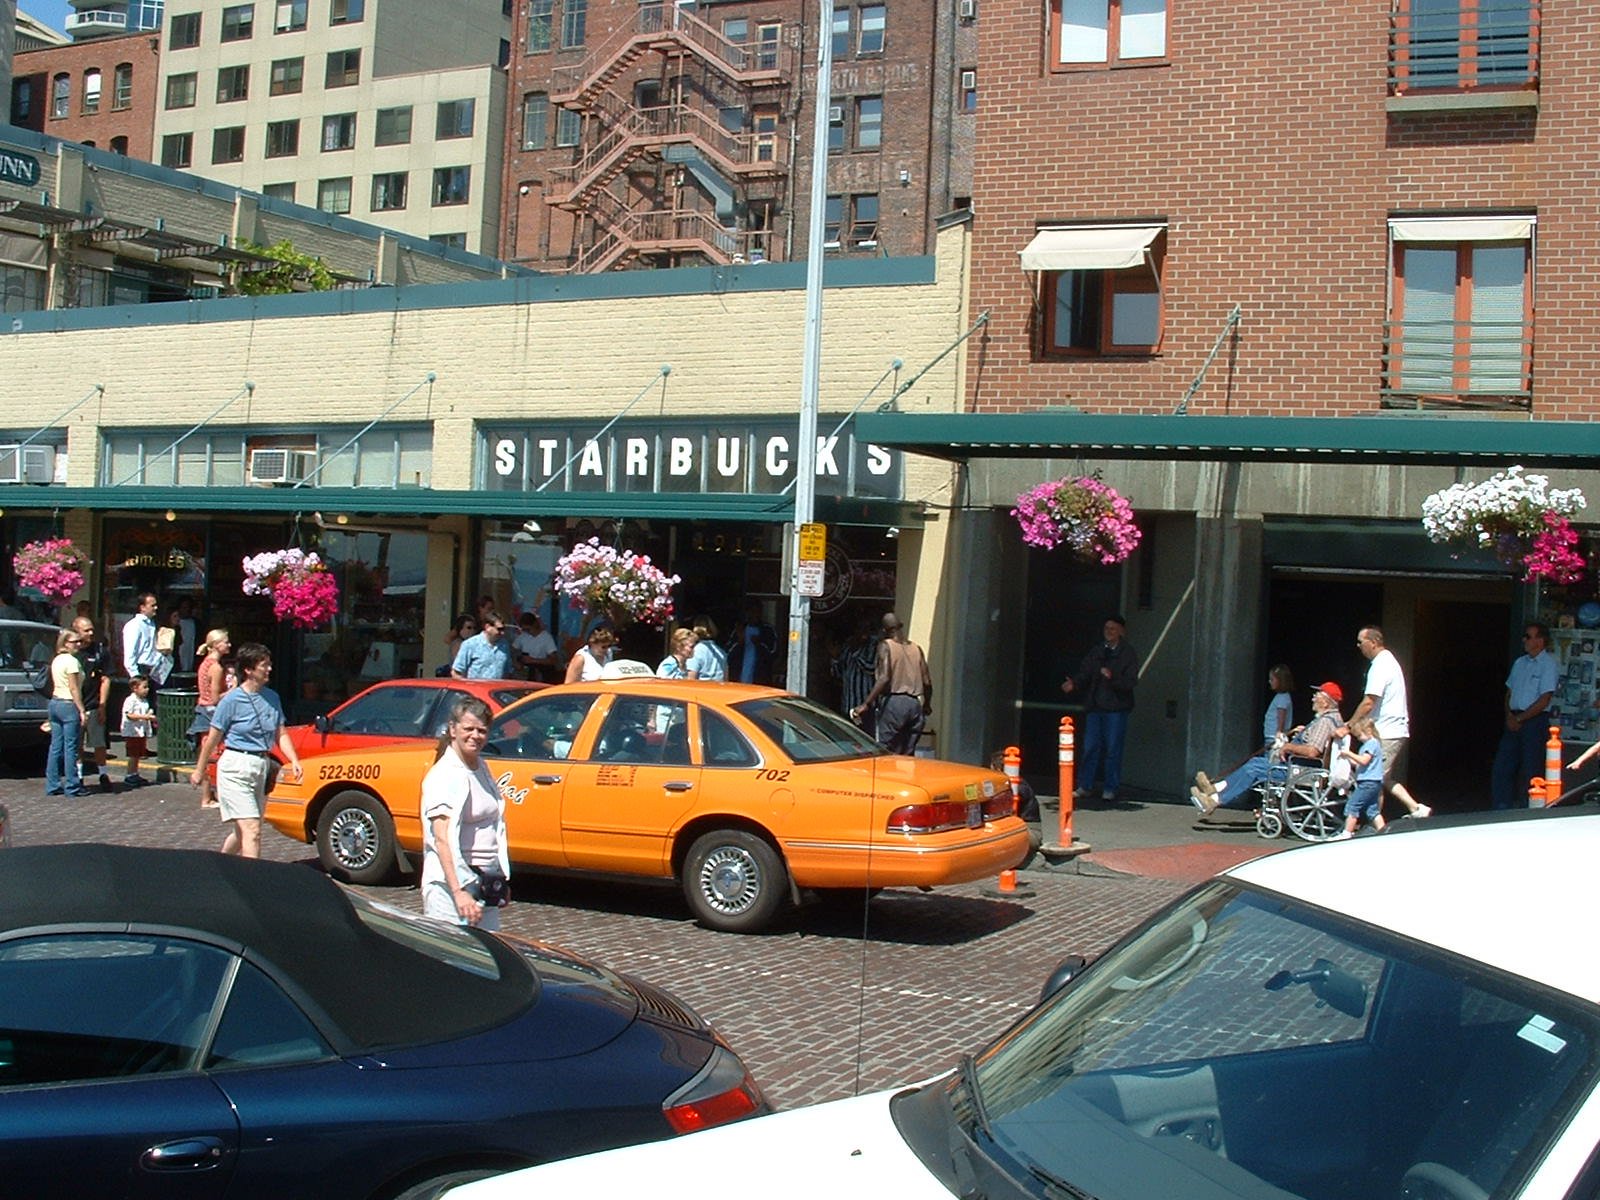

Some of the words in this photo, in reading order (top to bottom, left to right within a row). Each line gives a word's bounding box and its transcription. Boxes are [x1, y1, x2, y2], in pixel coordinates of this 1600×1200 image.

[495, 436, 891, 476] STARBUCKS
[319, 764, 381, 780] 522-8800
[755, 768, 790, 782] 702
[816, 788, 852, 796] COMPUTER
